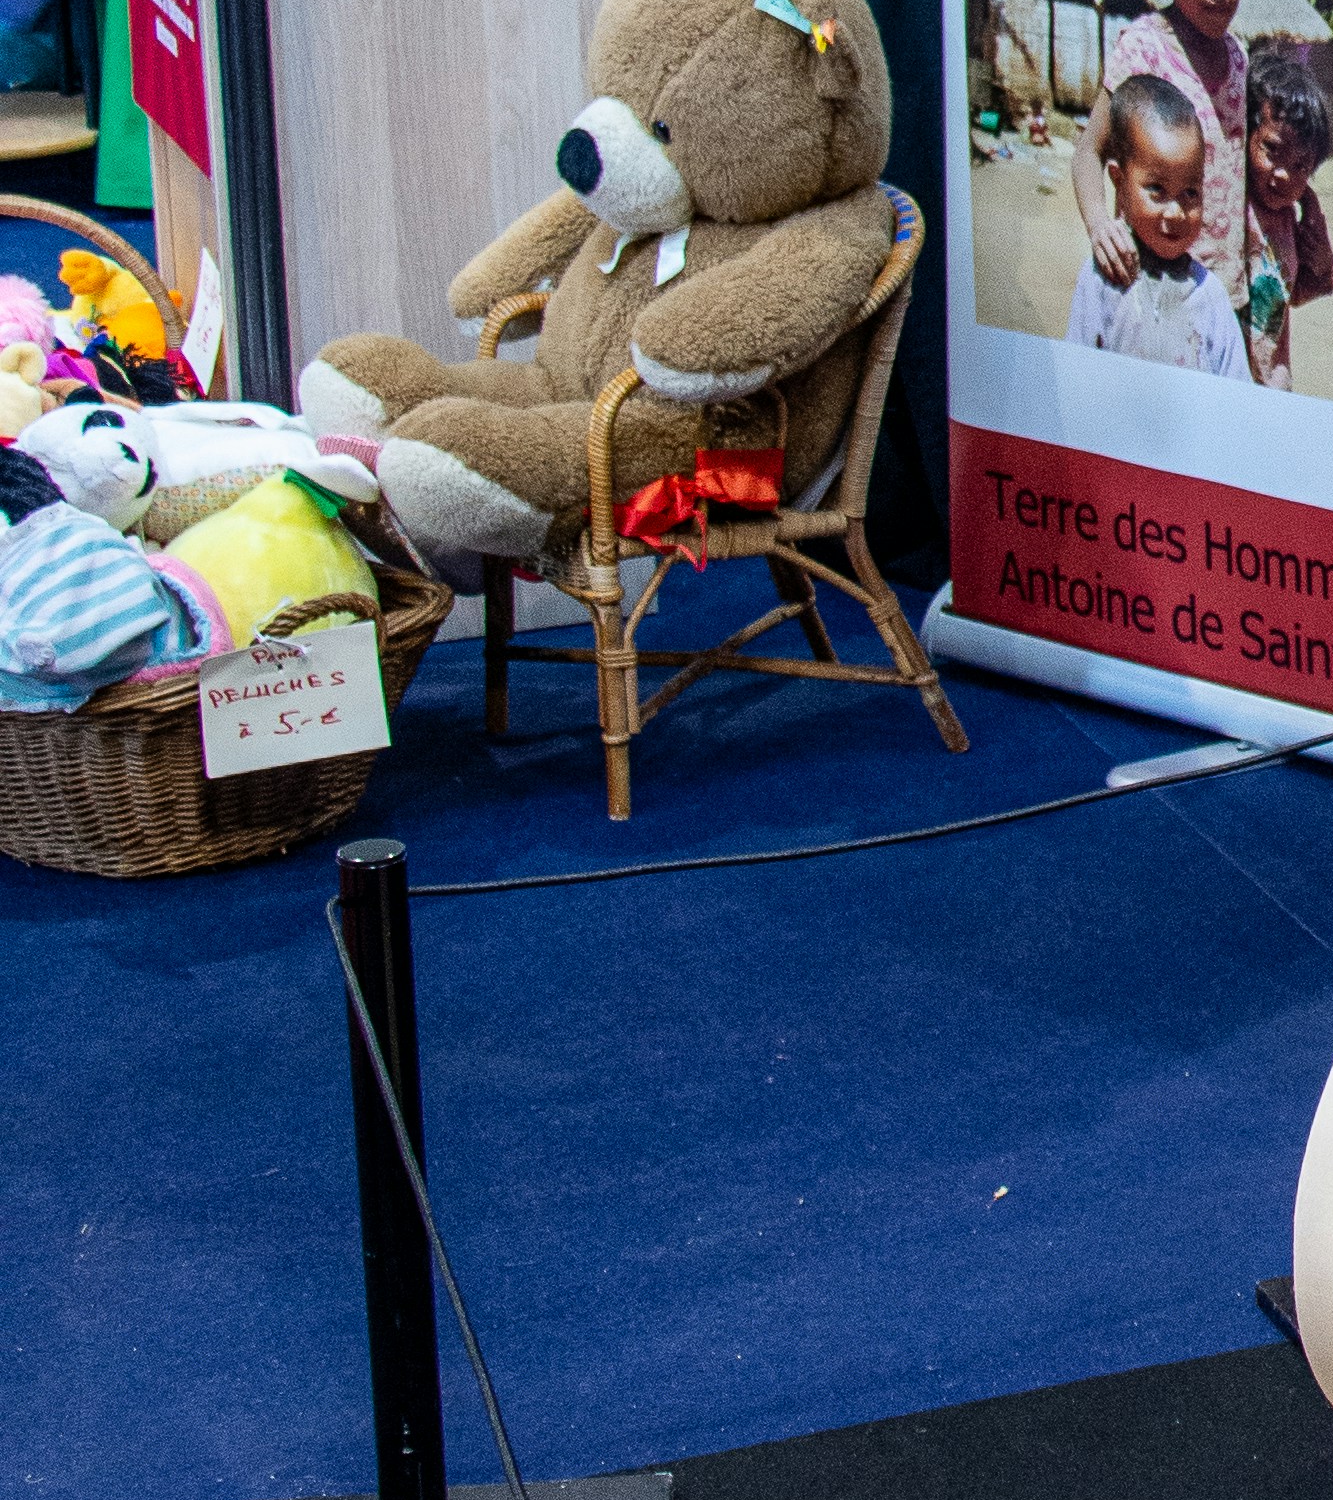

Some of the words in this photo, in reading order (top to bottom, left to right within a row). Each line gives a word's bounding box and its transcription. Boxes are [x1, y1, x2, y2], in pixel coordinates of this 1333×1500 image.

[985, 470, 1099, 543] Terre
[1113, 502, 1188, 564] des
[999, 550, 1156, 635] Antoine
[1172, 593, 1224, 652] de
[208, 669, 346, 709] PELUCHES
